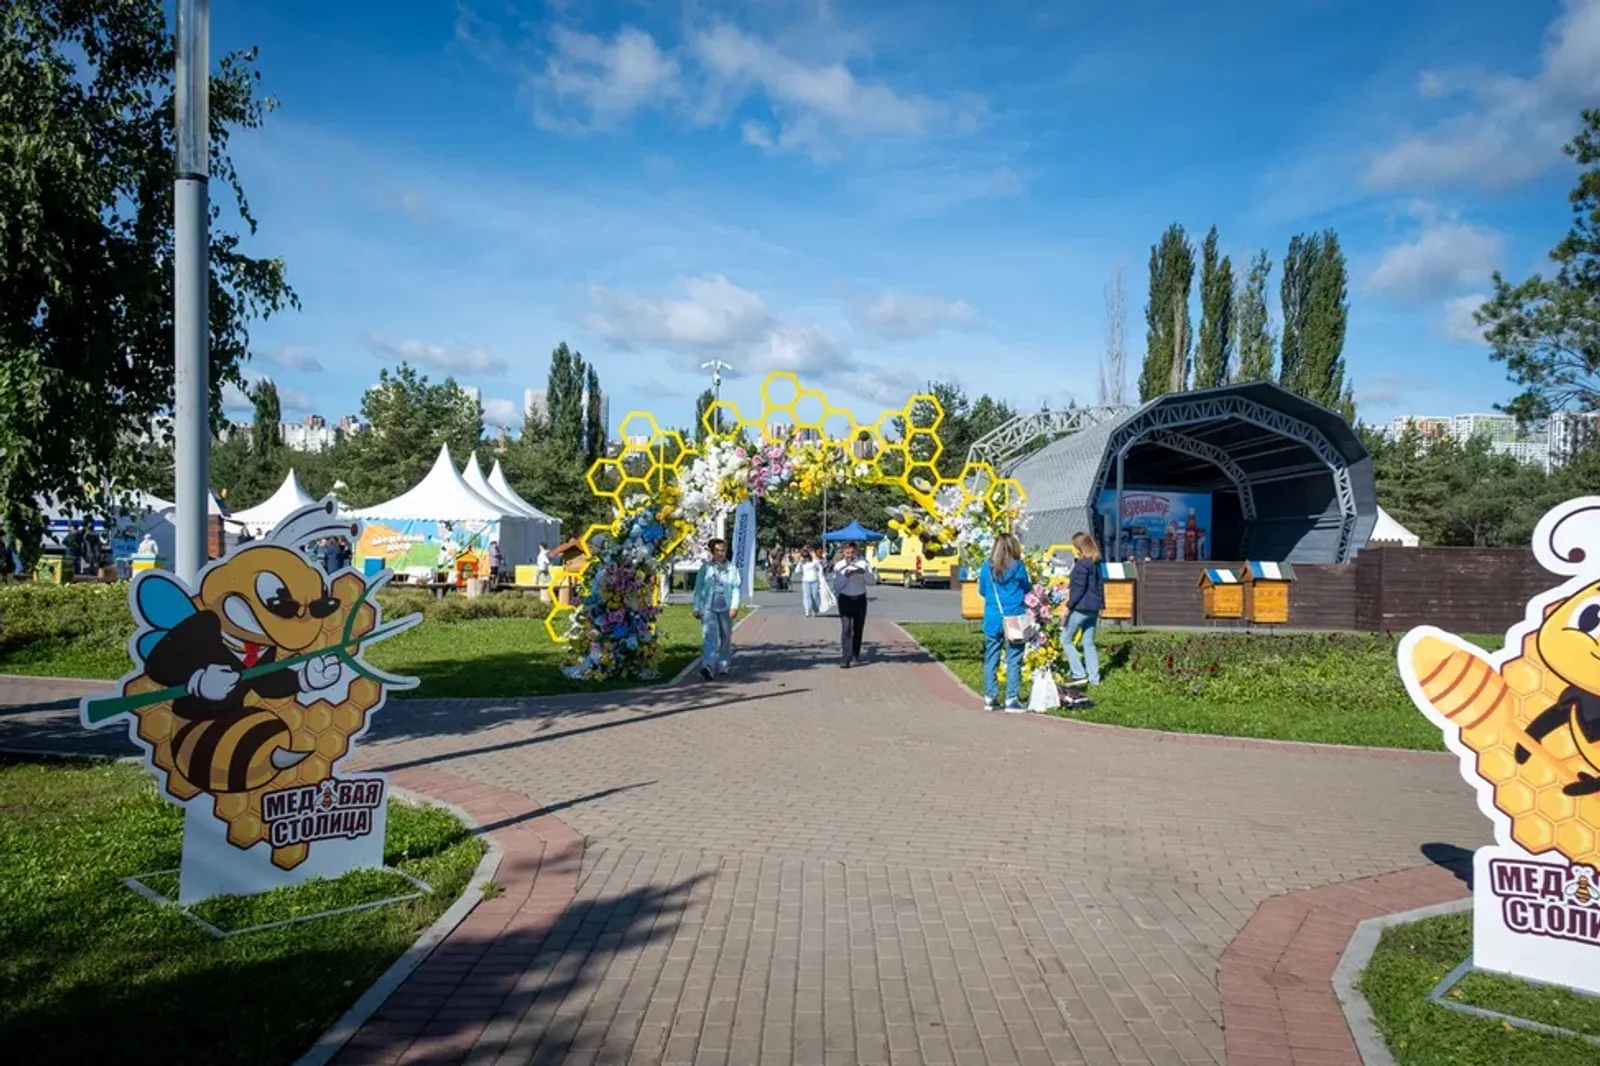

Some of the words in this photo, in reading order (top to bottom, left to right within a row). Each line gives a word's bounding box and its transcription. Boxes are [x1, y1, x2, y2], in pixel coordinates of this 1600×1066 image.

[265, 782, 379, 818] МЕДВАЯ
[273, 810, 368, 843] СТОЛИЦА
[1496, 865, 1599, 902] МЕД
